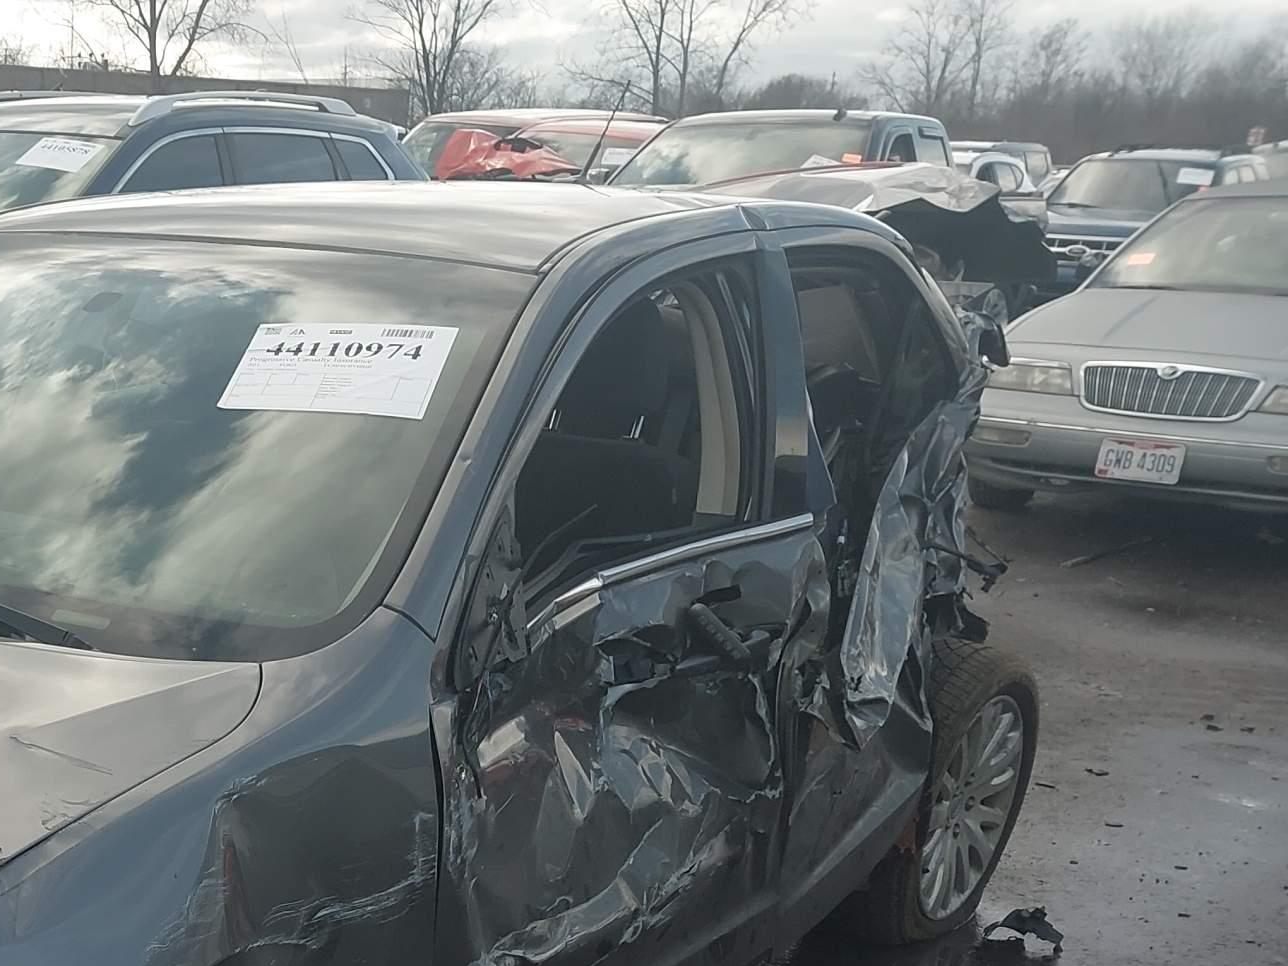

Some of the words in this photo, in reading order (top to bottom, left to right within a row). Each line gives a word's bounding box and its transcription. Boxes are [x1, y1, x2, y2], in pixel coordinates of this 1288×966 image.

[266, 341, 423, 361] 44110974
[1103, 448, 1134, 470] GWB
[1136, 452, 1177, 473] 4309
